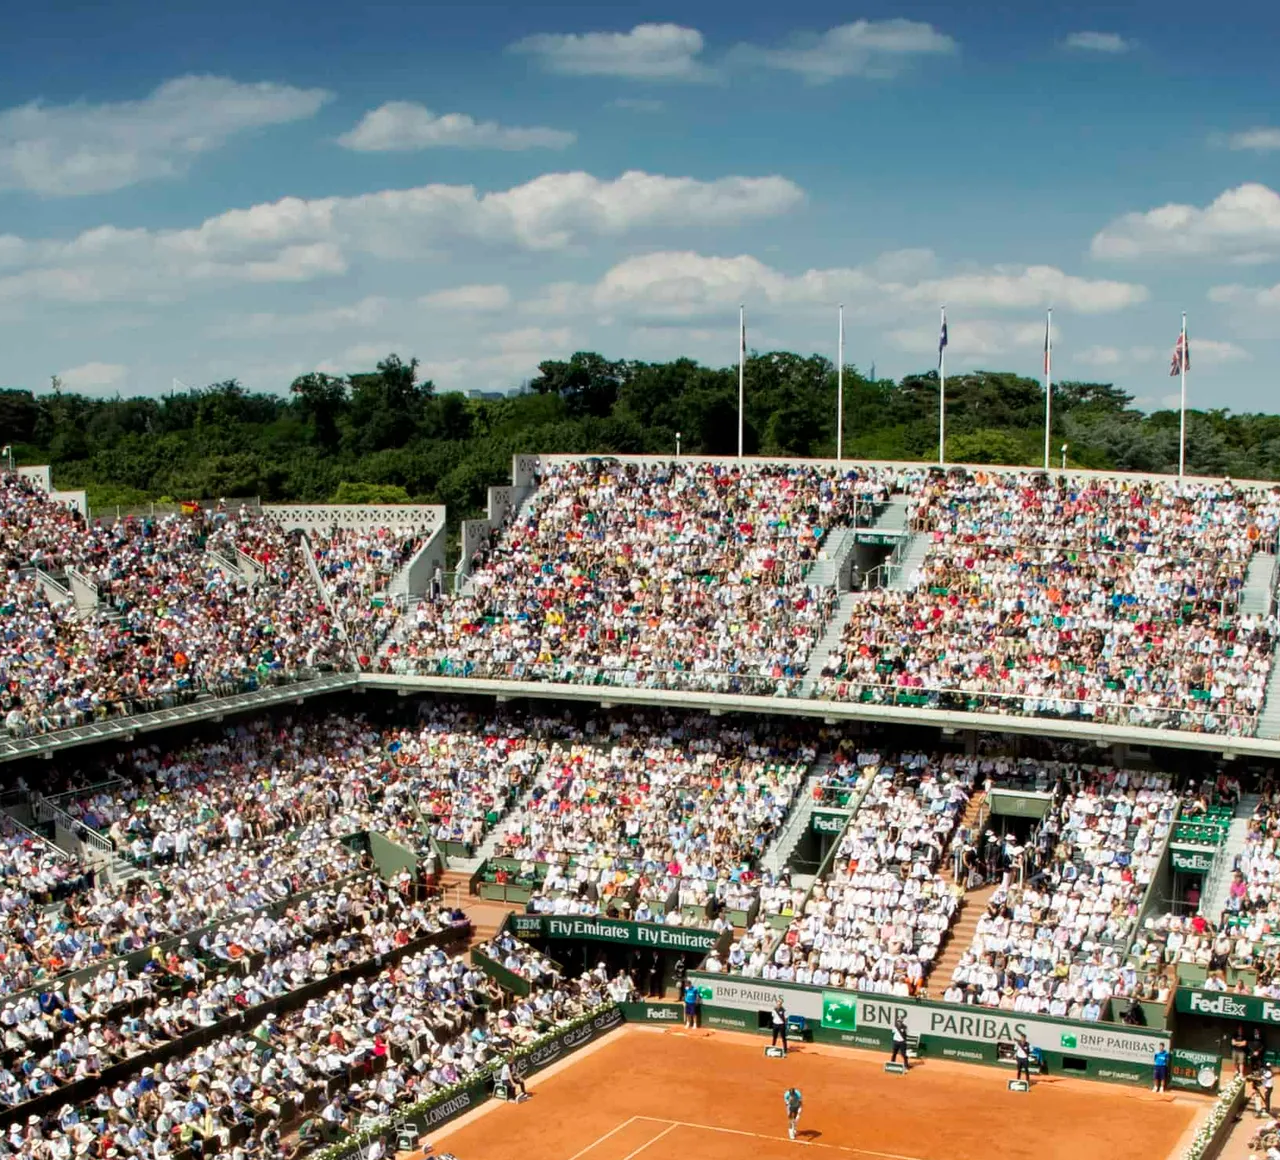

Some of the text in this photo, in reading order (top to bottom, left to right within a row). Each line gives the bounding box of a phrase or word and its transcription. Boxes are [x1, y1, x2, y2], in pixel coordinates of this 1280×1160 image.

[517, 918, 540, 930] IBM
[549, 920, 573, 936] Fly
[574, 921, 629, 939] Emirates
[637, 926, 659, 944] Fly
[661, 930, 716, 949] Emirates
[716, 986, 784, 1003] BNP PARIBAS
[1190, 992, 1246, 1017] FedEx
[647, 1008, 678, 1020] FedEx
[862, 1003, 1026, 1042] BNP PARIBAS
[1080, 1034, 1105, 1046] BNP
[1107, 1037, 1155, 1054] PARIBAS
[1176, 1050, 1217, 1063] LONGINES
[423, 1092, 470, 1126] LONGINES
